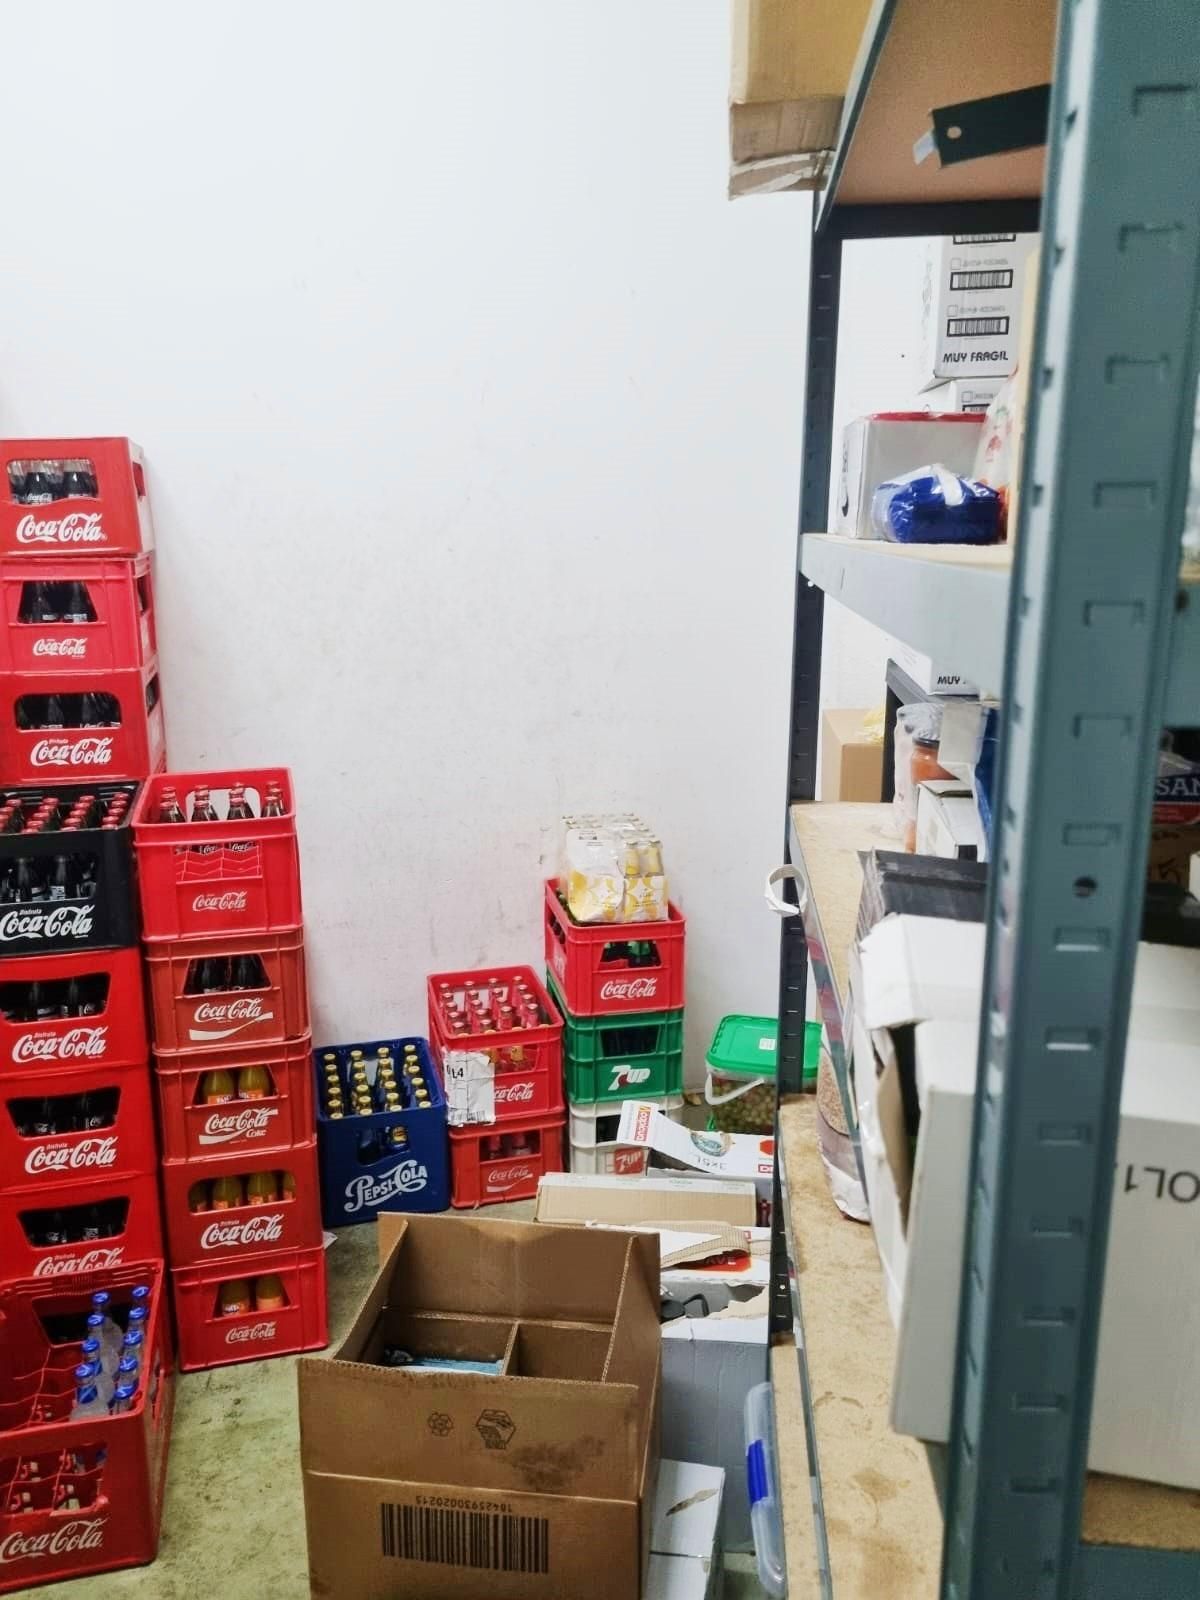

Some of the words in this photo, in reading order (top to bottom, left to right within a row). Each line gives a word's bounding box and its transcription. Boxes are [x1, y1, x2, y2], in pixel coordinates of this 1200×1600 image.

[943, 352, 967, 363] MUY
[970, 351, 1009, 362] FRAGIL
[16, 513, 103, 543] Coca-Cola
[33, 638, 88, 656] Coca-Cola
[937, 676, 961, 685] MUY
[30, 737, 113, 766] Coca-Cola
[193, 891, 247, 912] Coca-Cola
[0, 905, 95, 941] Coca-Cola
[601, 977, 657, 1000] Coca-Cola
[195, 999, 263, 1023] Coca-Cola
[12, 1026, 108, 1063] Coca-Cola
[495, 1082, 534, 1102] ca-Cola
[205, 1107, 270, 1134] Coca-Cola
[25, 1136, 118, 1174] Coca-Cola
[201, 1213, 284, 1249] Coca-Cola
[225, 1321, 277, 1344] Coca-Cola
[0, 1518, 110, 1563] Coca-Cola
